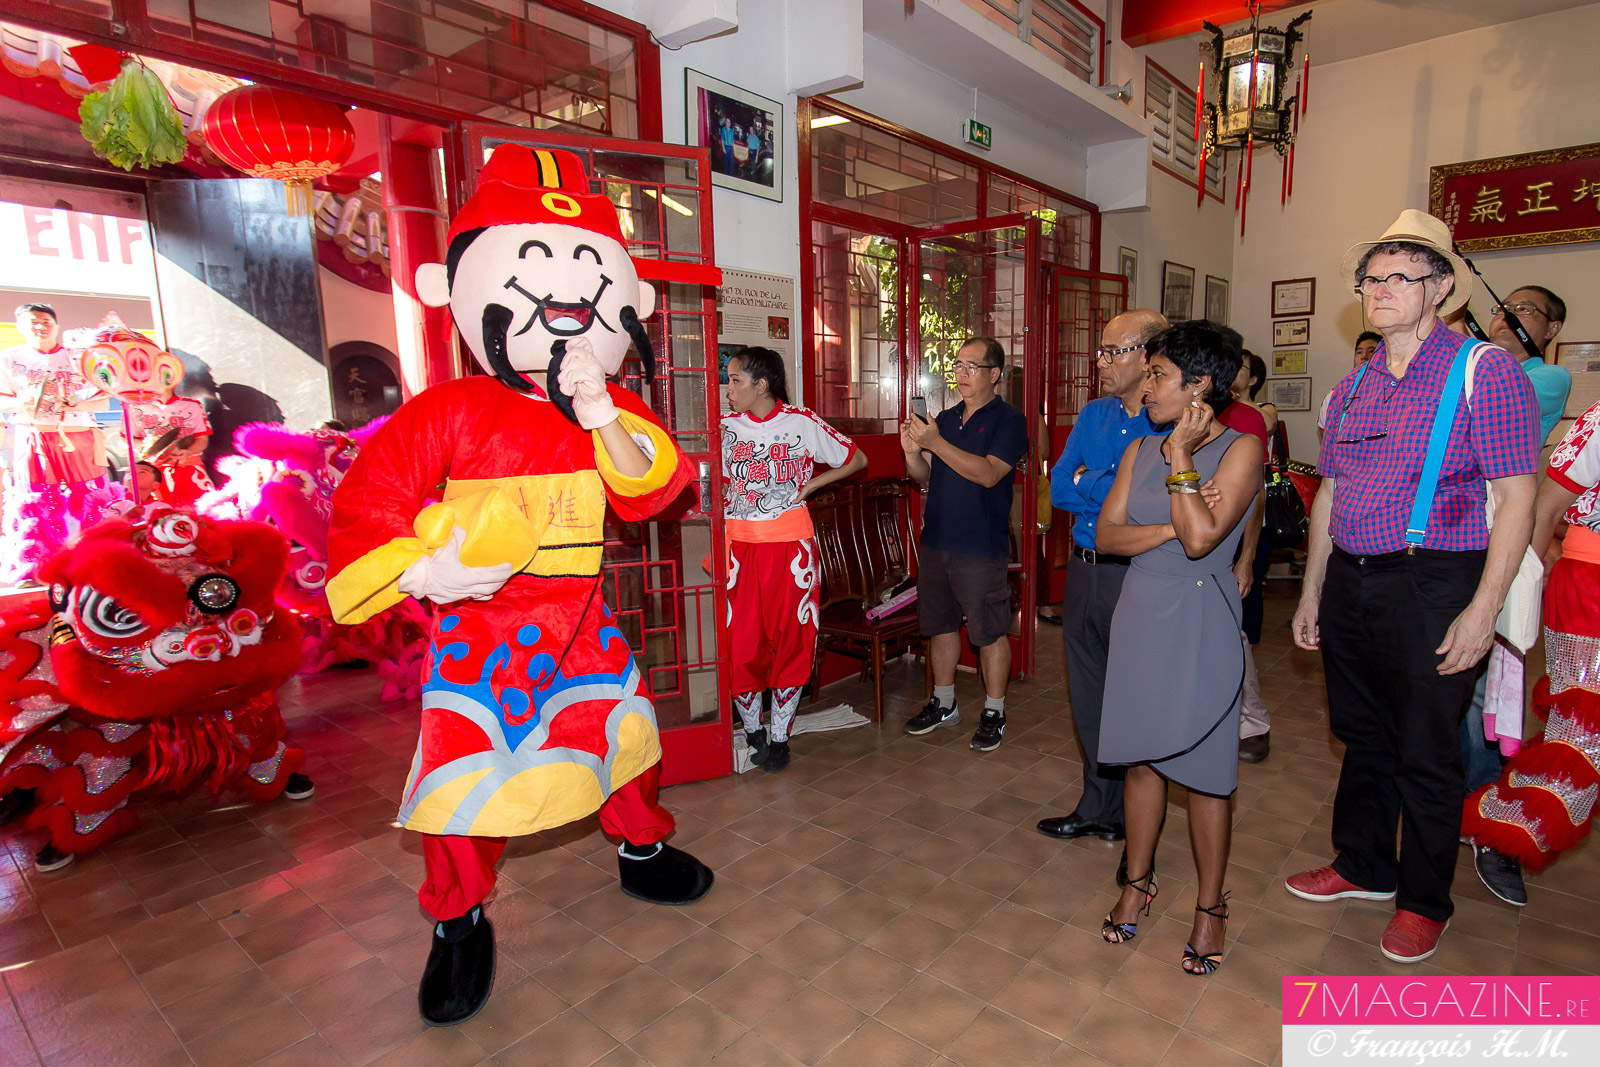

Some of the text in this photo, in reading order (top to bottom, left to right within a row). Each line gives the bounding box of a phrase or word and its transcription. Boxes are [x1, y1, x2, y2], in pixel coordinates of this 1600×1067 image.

[745, 288, 759, 298] ROI
[760, 290, 770, 299] DE
[771, 292, 781, 300] LA
[755, 299, 788, 310] MILITAIRE
[1516, 327, 1529, 342] Canon
[769, 444, 789, 461] QI
[775, 460, 800, 482] LIN
